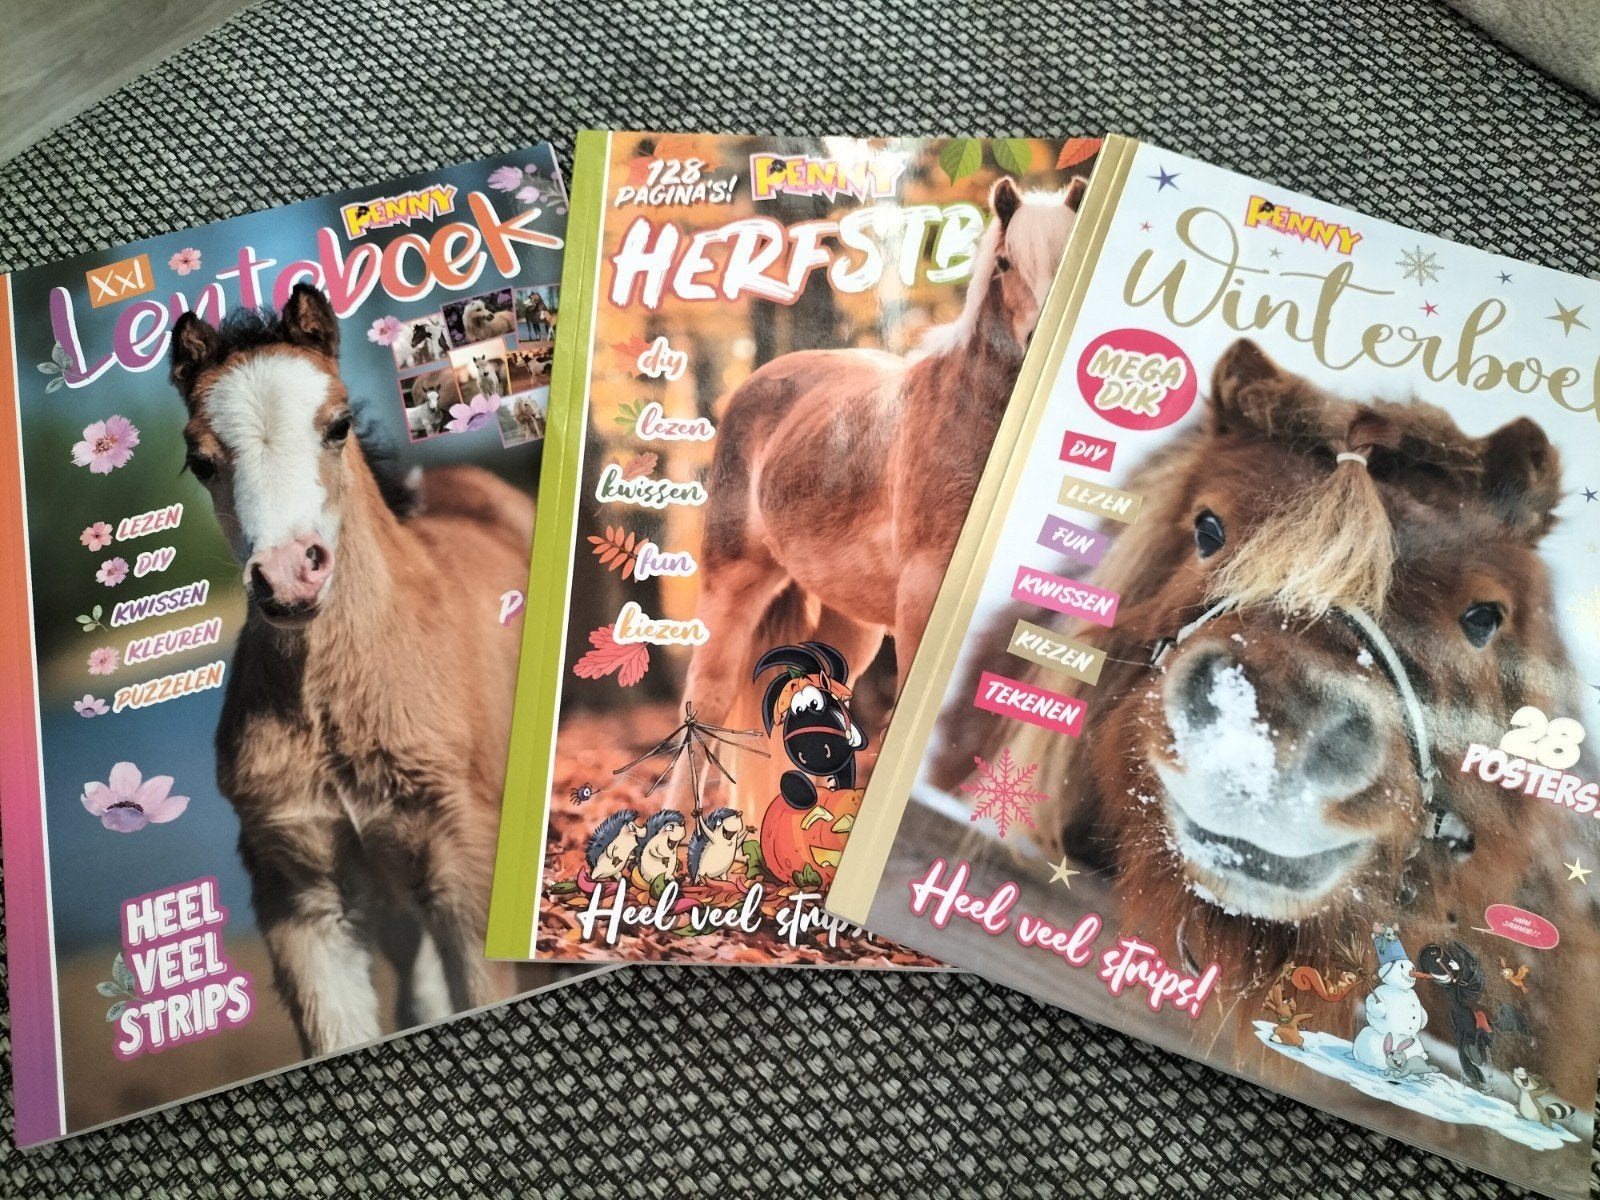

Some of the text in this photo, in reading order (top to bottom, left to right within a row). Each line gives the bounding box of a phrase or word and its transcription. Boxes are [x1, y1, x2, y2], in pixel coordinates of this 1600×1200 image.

[614, 174, 738, 208] PAGINA'S!
[646, 157, 704, 186] 128
[751, 153, 903, 203] PENNY
[341, 185, 457, 239] PENNY
[1244, 196, 1362, 255] PENNY
[1122, 206, 1600, 425] Winterboe
[641, 339, 684, 379] diy
[1088, 347, 1184, 388] MEGA
[1097, 380, 1163, 415] DIK
[638, 404, 712, 438] lezen
[1067, 439, 1108, 463] DIY
[598, 466, 705, 508] kwissen
[1066, 484, 1133, 516] LEZEN
[118, 505, 182, 540] LEZEN
[1052, 526, 1096, 555] FUN
[135, 548, 175, 576] DIY
[637, 545, 693, 578] fun
[112, 581, 208, 625] KWISSEN
[1018, 573, 1114, 617] KWISSEN
[126, 619, 220, 663] KLEUREN
[616, 604, 707, 642] kiezen
[1014, 629, 1094, 673] KIEZEN
[115, 663, 224, 711] PUZZELEN
[985, 680, 1081, 726] TEKENEN
[1500, 705, 1586, 770] 28
[126, 881, 223, 946] HEEL
[577, 877, 678, 945] Heel
[690, 882, 770, 933] veel
[911, 860, 1219, 1016] Heel veel strips!
[132, 931, 227, 995] VEEL
[119, 976, 249, 1055] STRIPS
